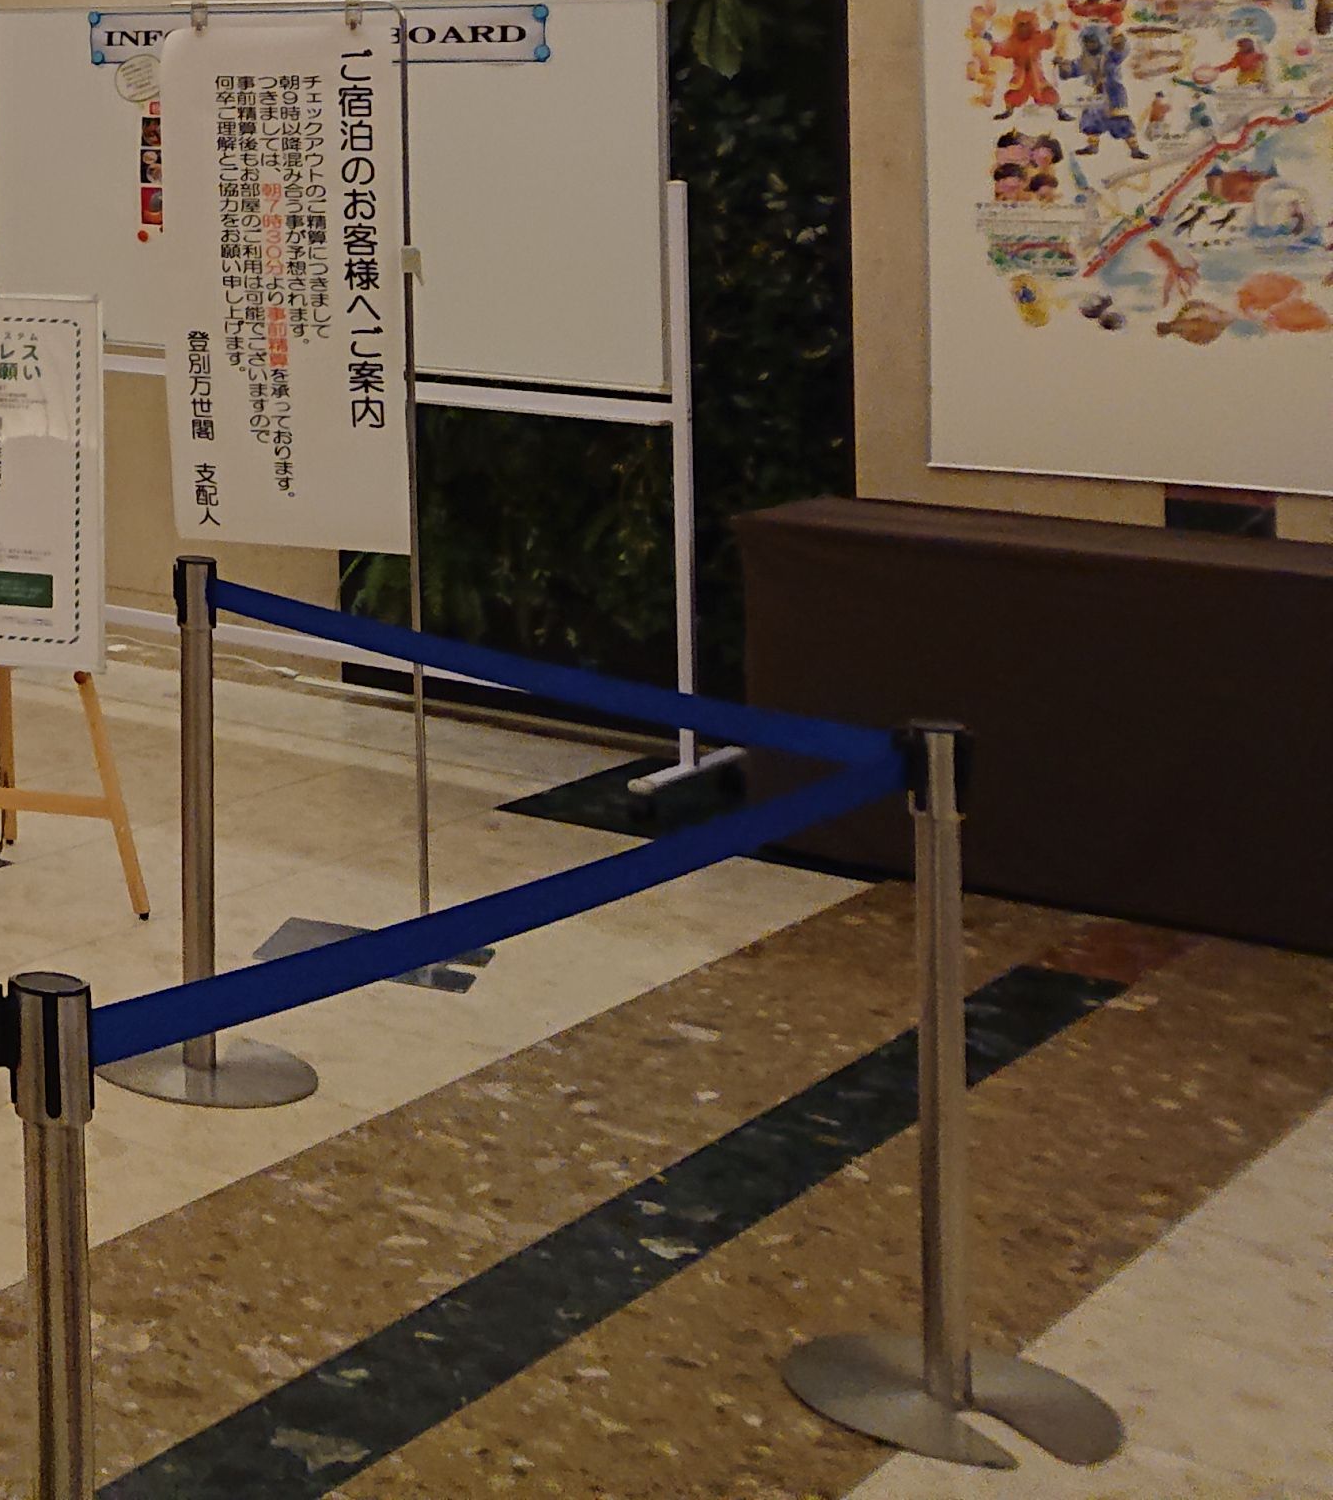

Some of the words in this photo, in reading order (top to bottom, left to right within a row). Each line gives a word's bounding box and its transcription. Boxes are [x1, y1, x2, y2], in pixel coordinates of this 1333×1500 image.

[104, 29, 174, 48] INF
[214, 74, 247, 372] 何卒ご理解とご協力をお願い申し上げます。
[236, 74, 271, 444] 事前精算後もお部屋のご利用は可能でございますので
[279, 74, 310, 345] 朝9時以降混み合う事が予想されます。
[301, 74, 332, 340] チェックアウトのご精算につきまして
[338, 48, 386, 429] ご宿泊のお客様へご案内
[187, 330, 215, 441] 登別万世閣
[194, 463, 221, 527] 支配人
